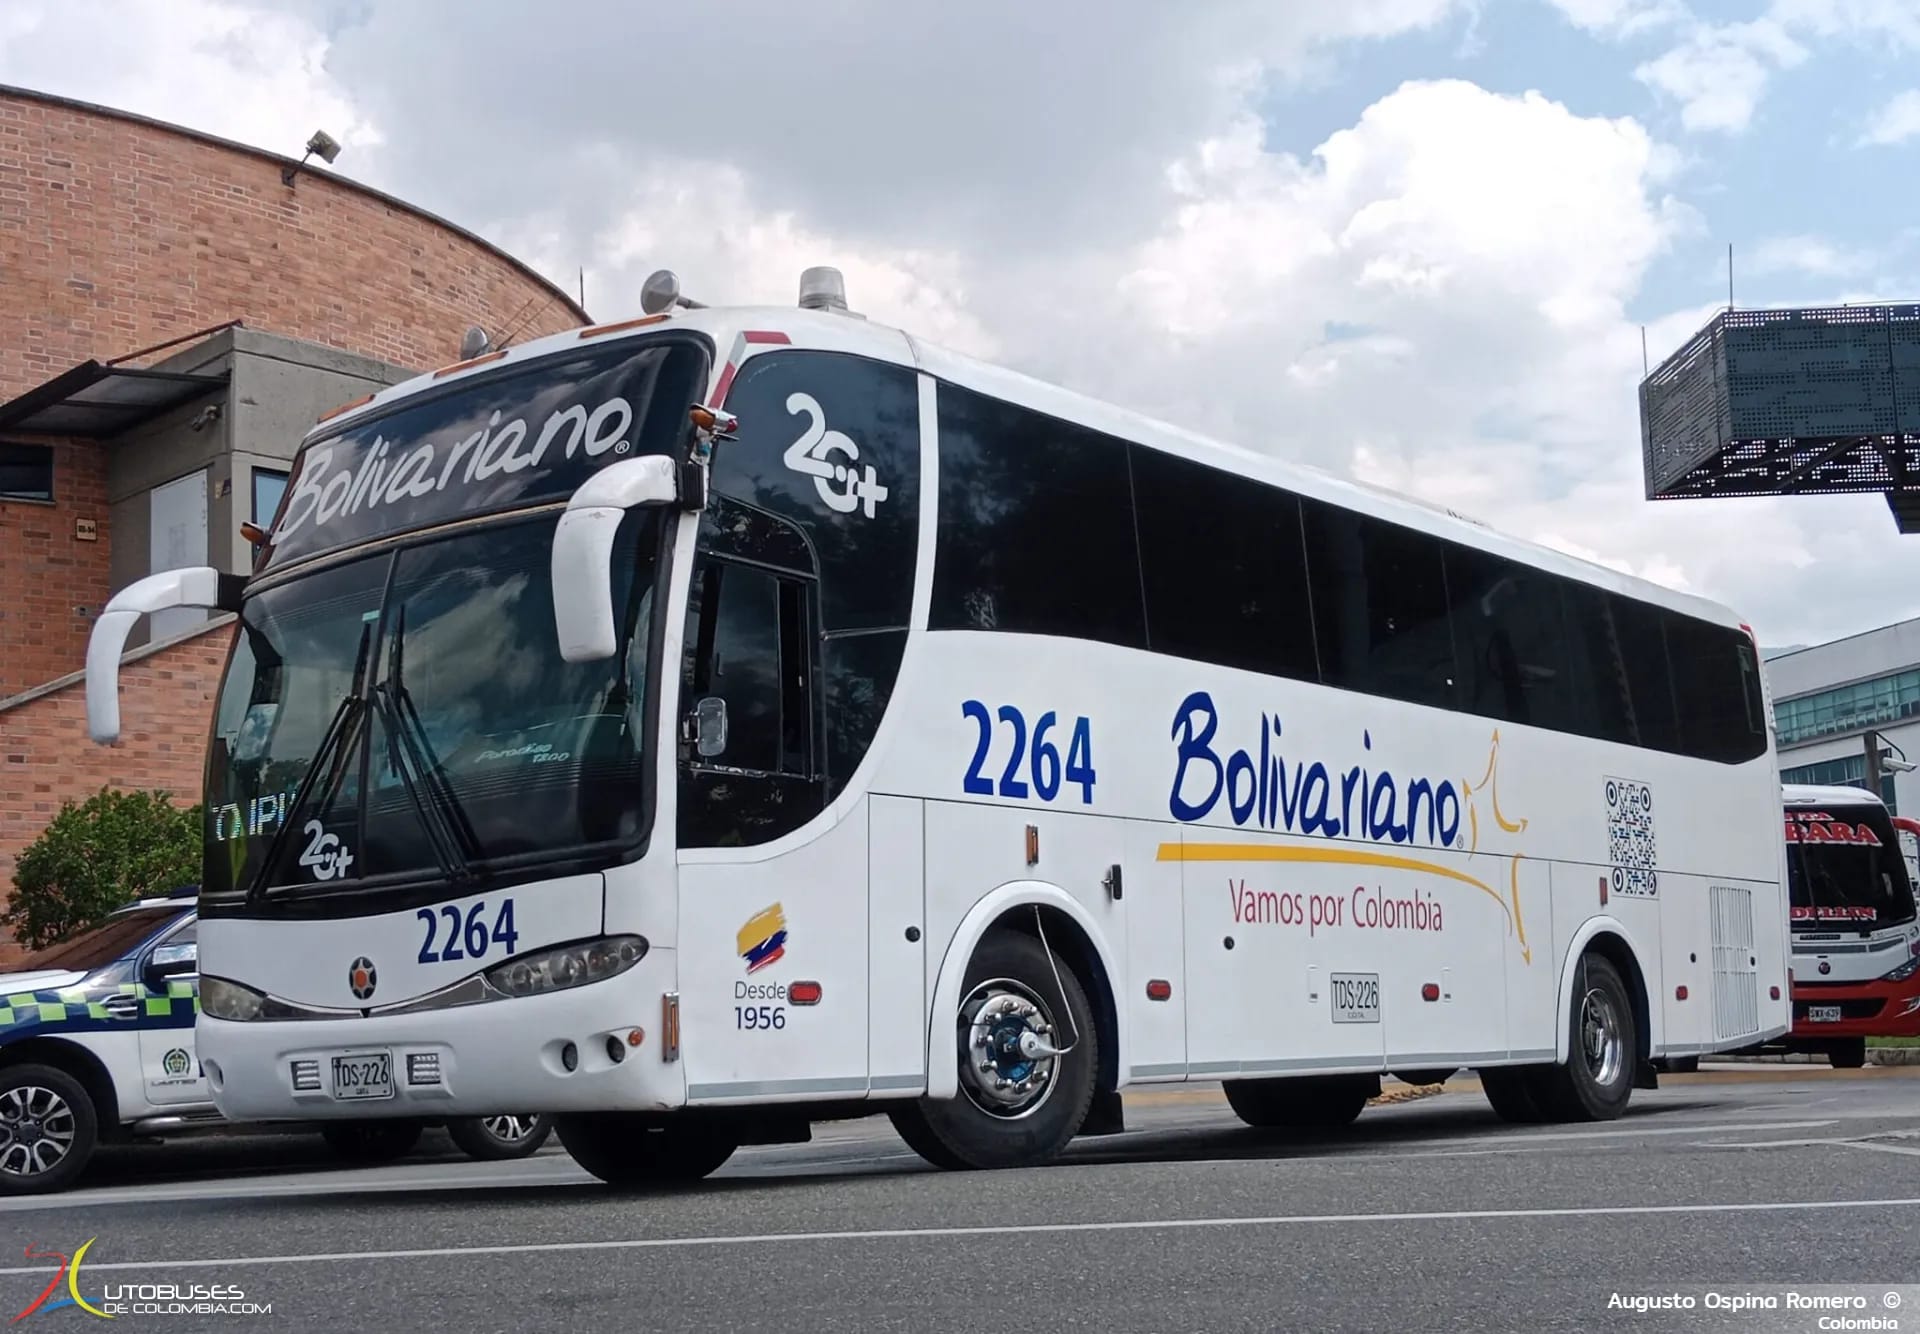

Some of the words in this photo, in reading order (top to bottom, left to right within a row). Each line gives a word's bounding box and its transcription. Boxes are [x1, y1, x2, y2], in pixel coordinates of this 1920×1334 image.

[962, 699, 1096, 805] 2264
[417, 898, 518, 964] 2264
[1229, 879, 1304, 926] Vamos
[1310, 894, 1345, 938] por
[1352, 885, 1443, 932] Colombia
[735, 980, 786, 999] Desde
[735, 1006, 786, 1030] 1956
